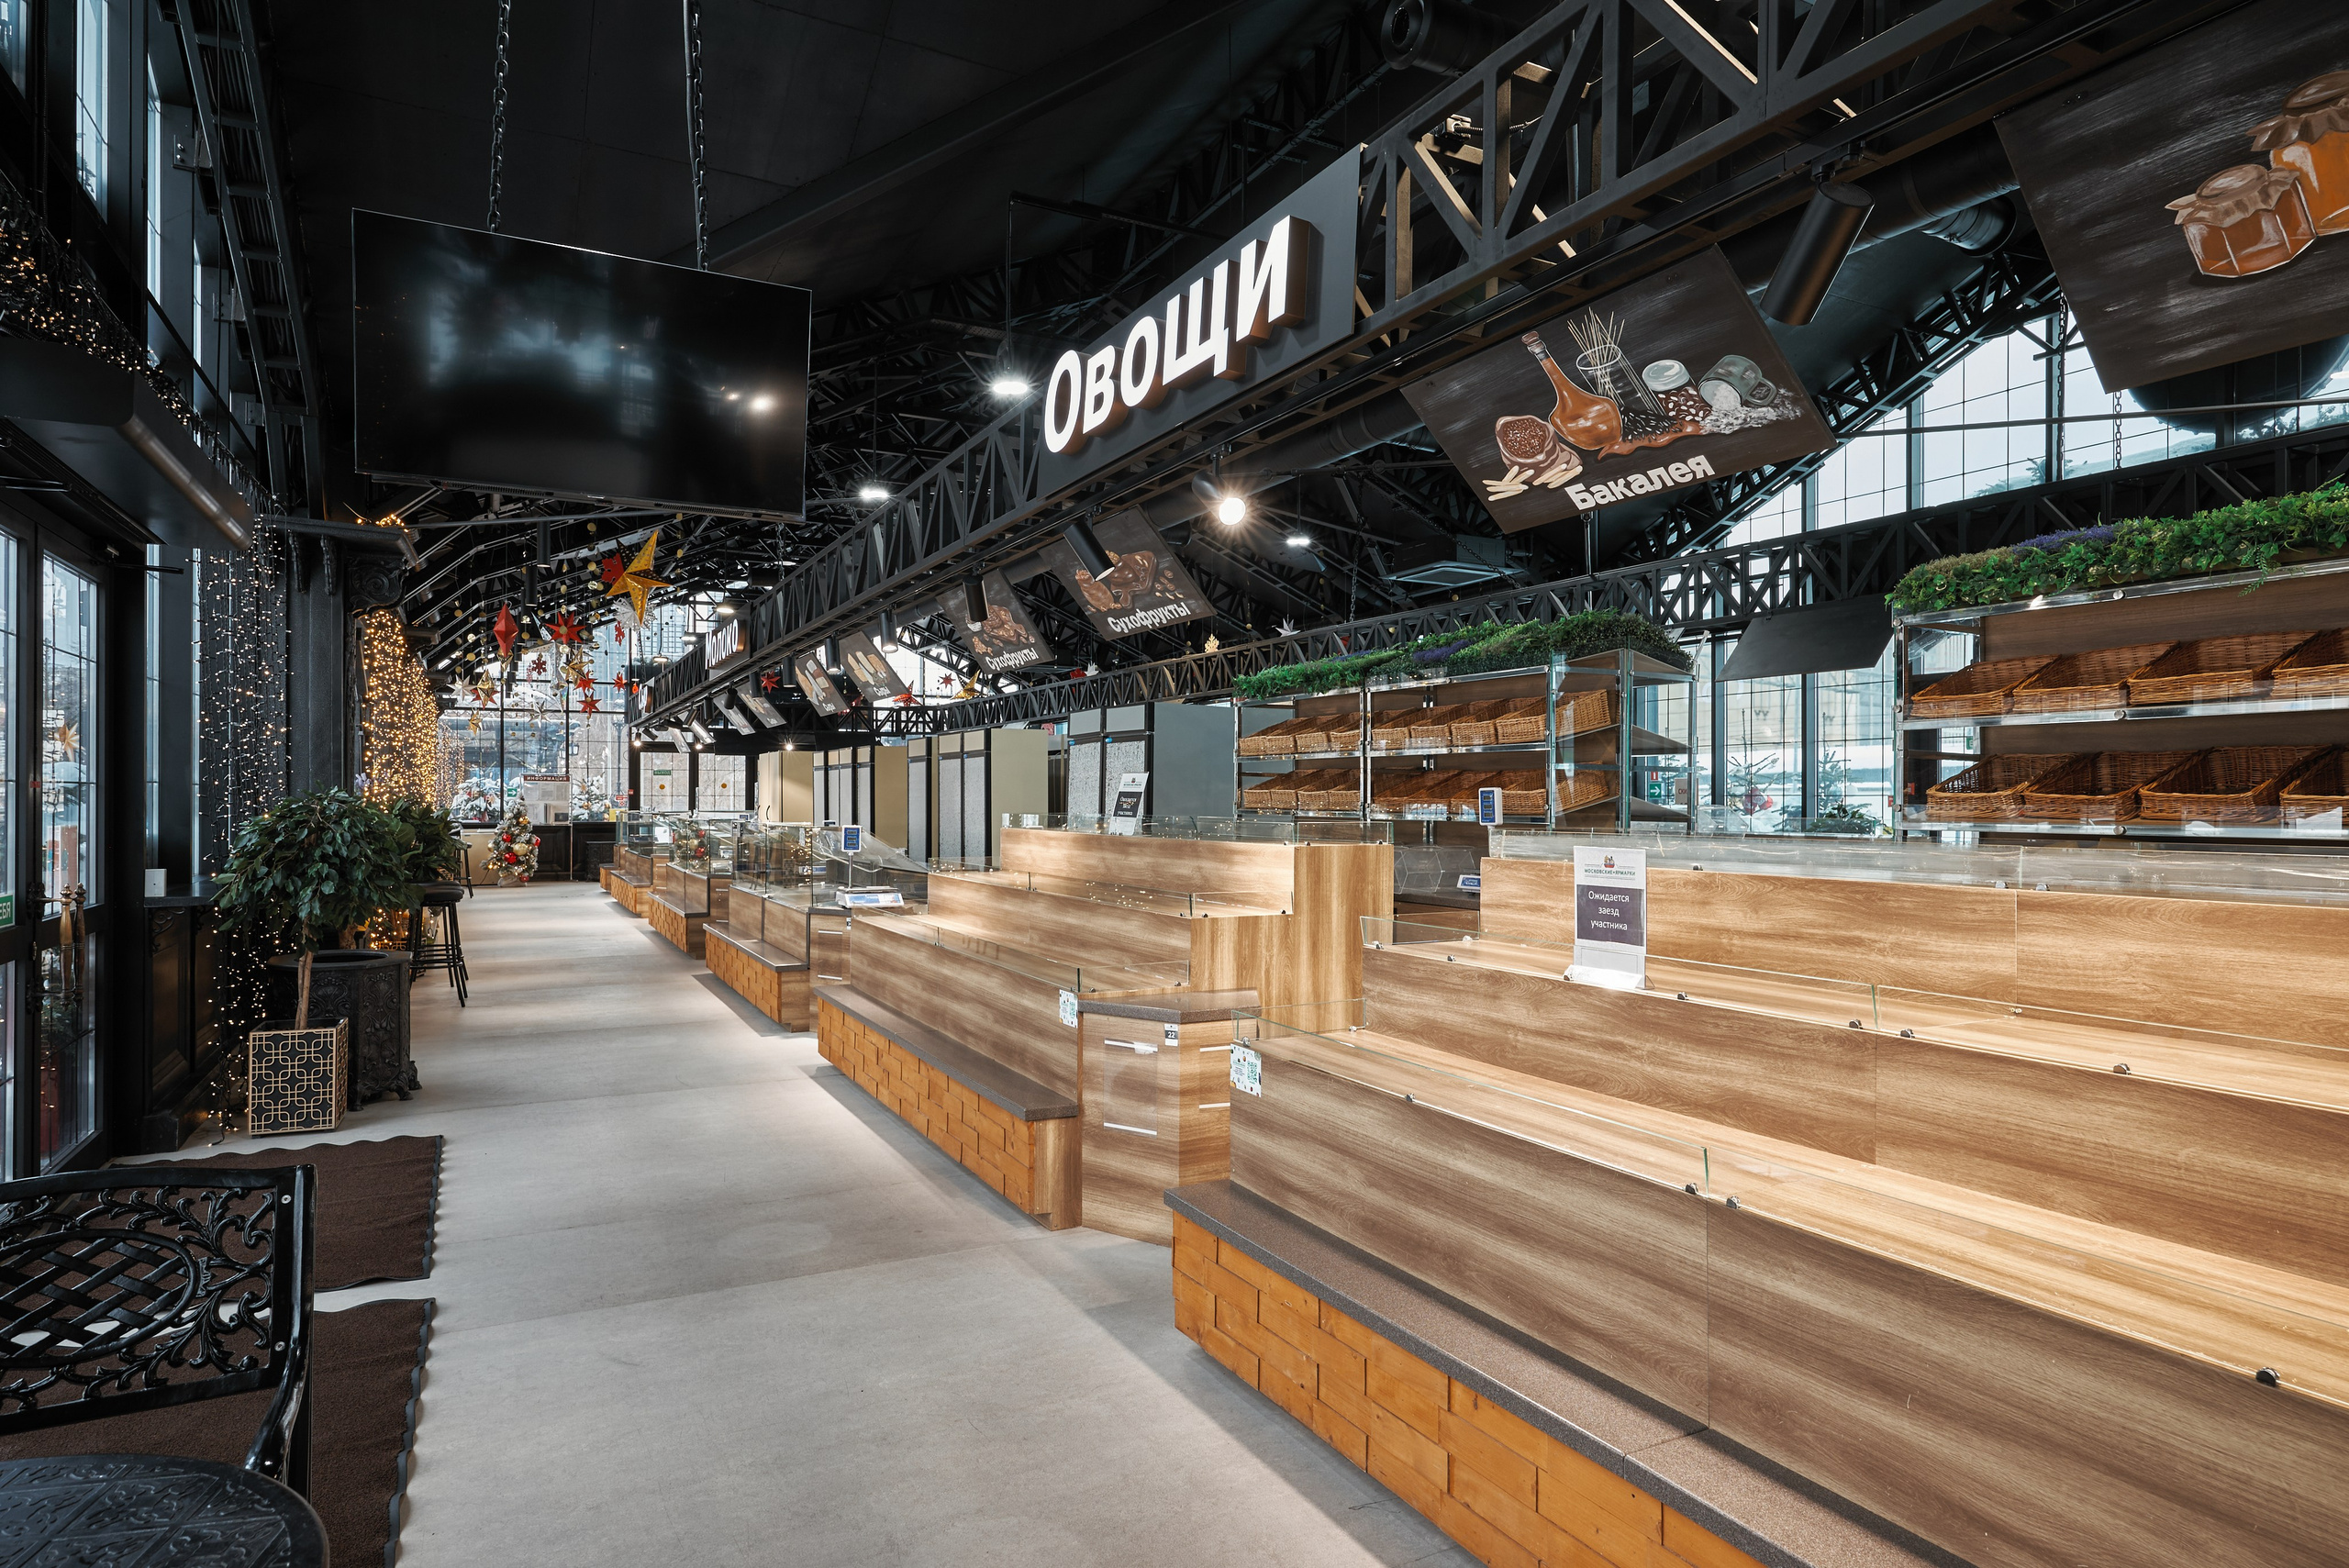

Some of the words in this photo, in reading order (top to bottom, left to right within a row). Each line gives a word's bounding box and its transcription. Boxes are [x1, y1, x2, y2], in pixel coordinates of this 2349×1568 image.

[1564, 454, 1716, 511] Бакалея
[1107, 601, 1191, 633] Сухофрукты
[985, 647, 1039, 672] Сухофрукты
[1588, 890, 1630, 903] Ожидается
[1598, 906, 1620, 917] заезд
[1590, 919, 1628, 931] участника
